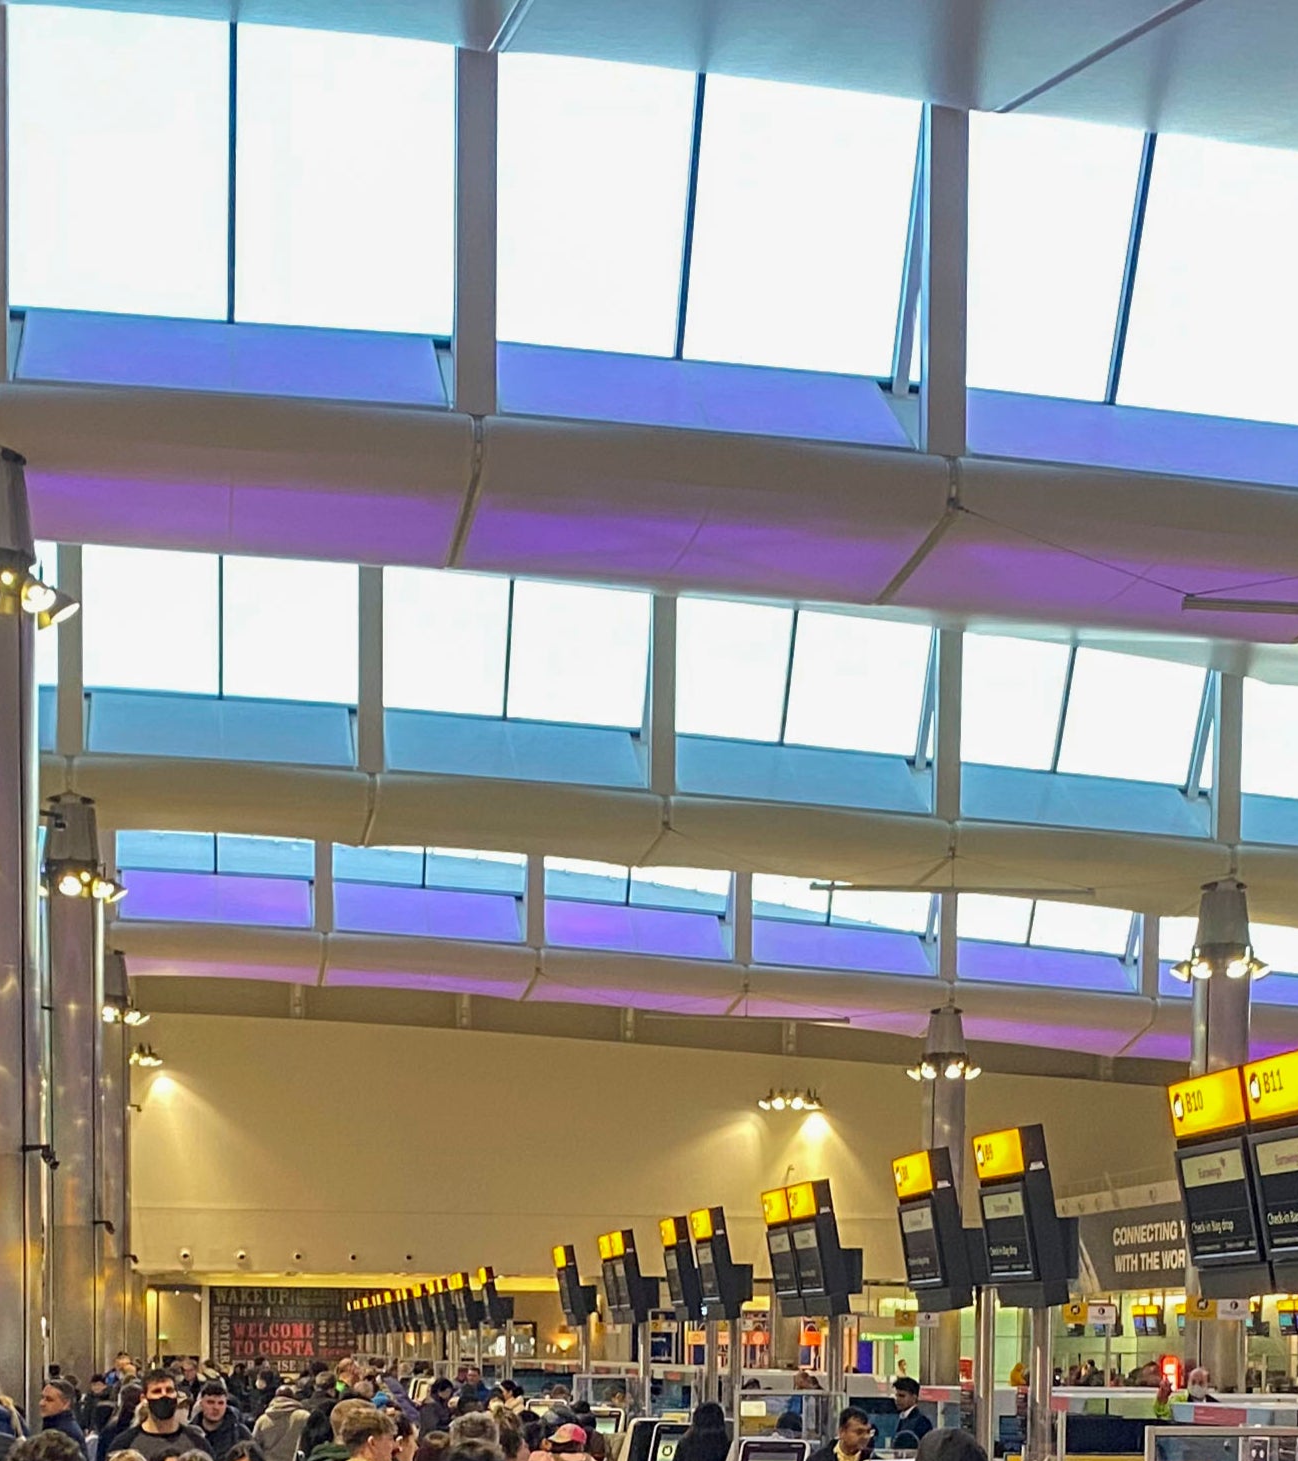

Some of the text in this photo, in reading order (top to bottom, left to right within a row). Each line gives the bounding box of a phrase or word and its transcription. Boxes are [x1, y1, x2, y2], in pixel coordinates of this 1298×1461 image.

[1263, 1069, 1284, 1094] B11
[1185, 1090, 1204, 1113] B10
[1267, 1211, 1291, 1226] Check-in
[1112, 1220, 1178, 1247] CONNECTING
[1114, 1248, 1186, 1273] WITH THE WOR
[214, 1288, 265, 1305] WAKE
[232, 1321, 315, 1338] WELCOME
[232, 1339, 315, 1356] TO COSTA
